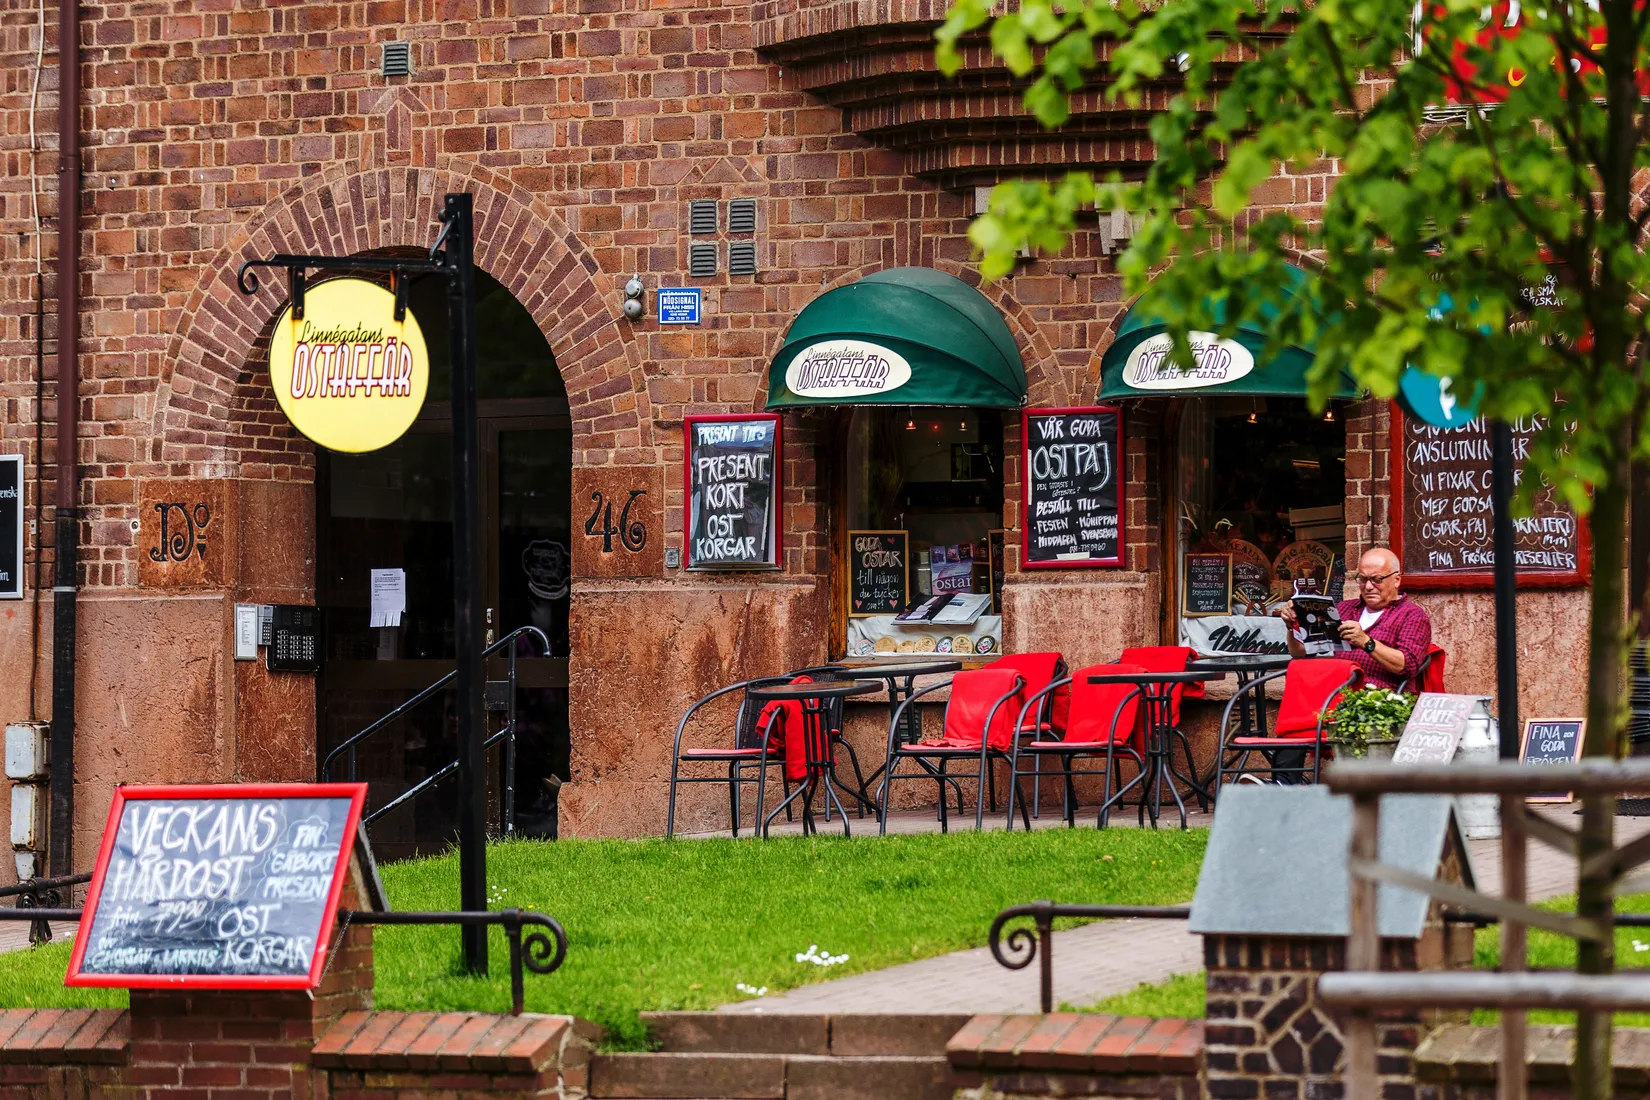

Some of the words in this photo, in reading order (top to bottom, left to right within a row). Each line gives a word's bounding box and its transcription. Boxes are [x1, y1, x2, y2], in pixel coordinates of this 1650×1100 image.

[297, 320, 384, 351] Linnégatans
[807, 346, 864, 360] Linnégatans
[291, 337, 413, 399] OSTAFFÄR
[796, 354, 890, 391] OSTAFFÄR
[698, 426, 739, 446] PRESENT
[742, 425, 766, 443] TIPS
[1037, 416, 1064, 440] VÅR
[1070, 418, 1101, 438] GODA
[698, 454, 769, 484] PRESENT
[1033, 441, 1112, 492] OSTPAJ
[1439, 471, 1479, 493] FIXAR
[706, 482, 750, 510] KORT
[1036, 496, 1072, 517] BESTÄLL
[1077, 498, 1100, 511] TILL
[1421, 498, 1448, 516] MED
[585, 490, 647, 552] 46
[707, 513, 744, 539] OST
[696, 536, 757, 561] KORGAR
[855, 537, 881, 552] GODA
[862, 551, 902, 568] OSTAR
[1429, 551, 1454, 569] FINA
[857, 569, 872, 586] till
[936, 576, 972, 590] ostar
[859, 588, 871, 599] du
[873, 587, 903, 600] tycker
[1421, 696, 1448, 709] GOTT
[1420, 709, 1457, 724] KAFFE
[1532, 725, 1560, 740] FINA
[1541, 740, 1565, 752] GODA
[131, 802, 278, 855] VECKANS
[112, 851, 255, 903] HÅRDOST
[263, 874, 333, 900] PRESENT
[218, 903, 282, 938] OST
[224, 936, 311, 968] KORGAR
